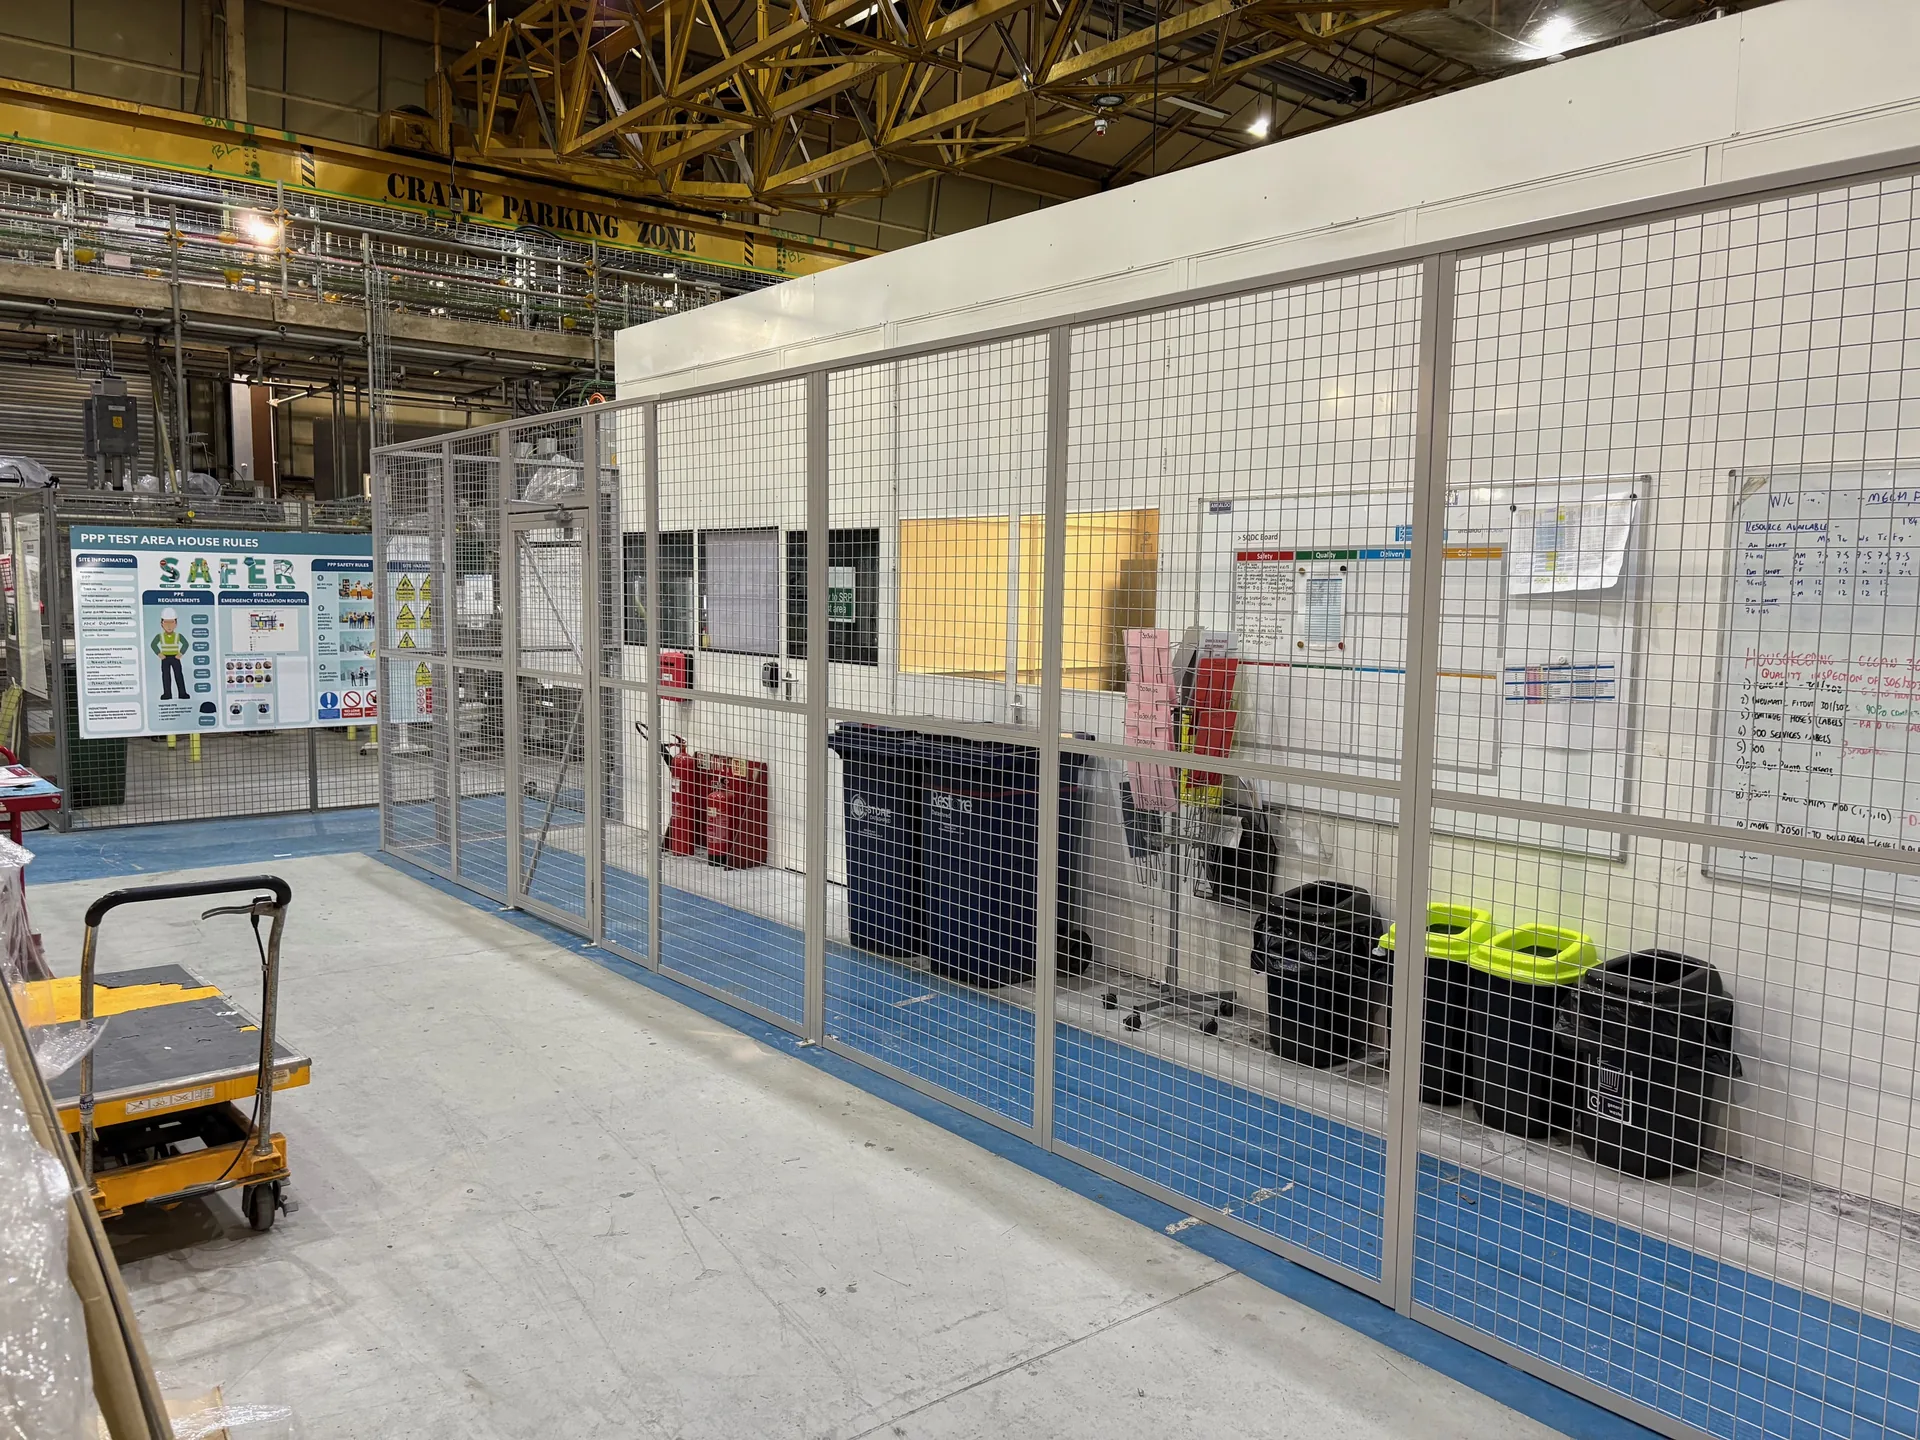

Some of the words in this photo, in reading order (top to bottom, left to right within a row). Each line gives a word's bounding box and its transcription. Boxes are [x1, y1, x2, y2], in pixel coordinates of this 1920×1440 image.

[387, 172, 483, 215] CRANE
[502, 194, 619, 239] PARKING
[637, 220, 696, 253] ZONE
[1745, 521, 1782, 532] RESOURCE
[1786, 522, 1828, 531] AVAILABLE
[81, 534, 106, 543] PPP
[108, 534, 139, 545] TEST
[141, 536, 175, 547] AREA
[179, 537, 222, 547] HOUSE
[226, 538, 260, 548] RULES
[1242, 534, 1259, 542] SQDC
[1260, 533, 1278, 541] Board
[1315, 552, 1336, 560] Quality
[1379, 550, 1405, 559] Delivery
[160, 557, 296, 585] SAFER
[838, 592, 853, 603] SRP
[832, 605, 847, 614] area
[1761, 667, 1802, 680] QUALITY
[1811, 669, 1863, 683] INSPECTION
[932, 791, 973, 813] Restore
